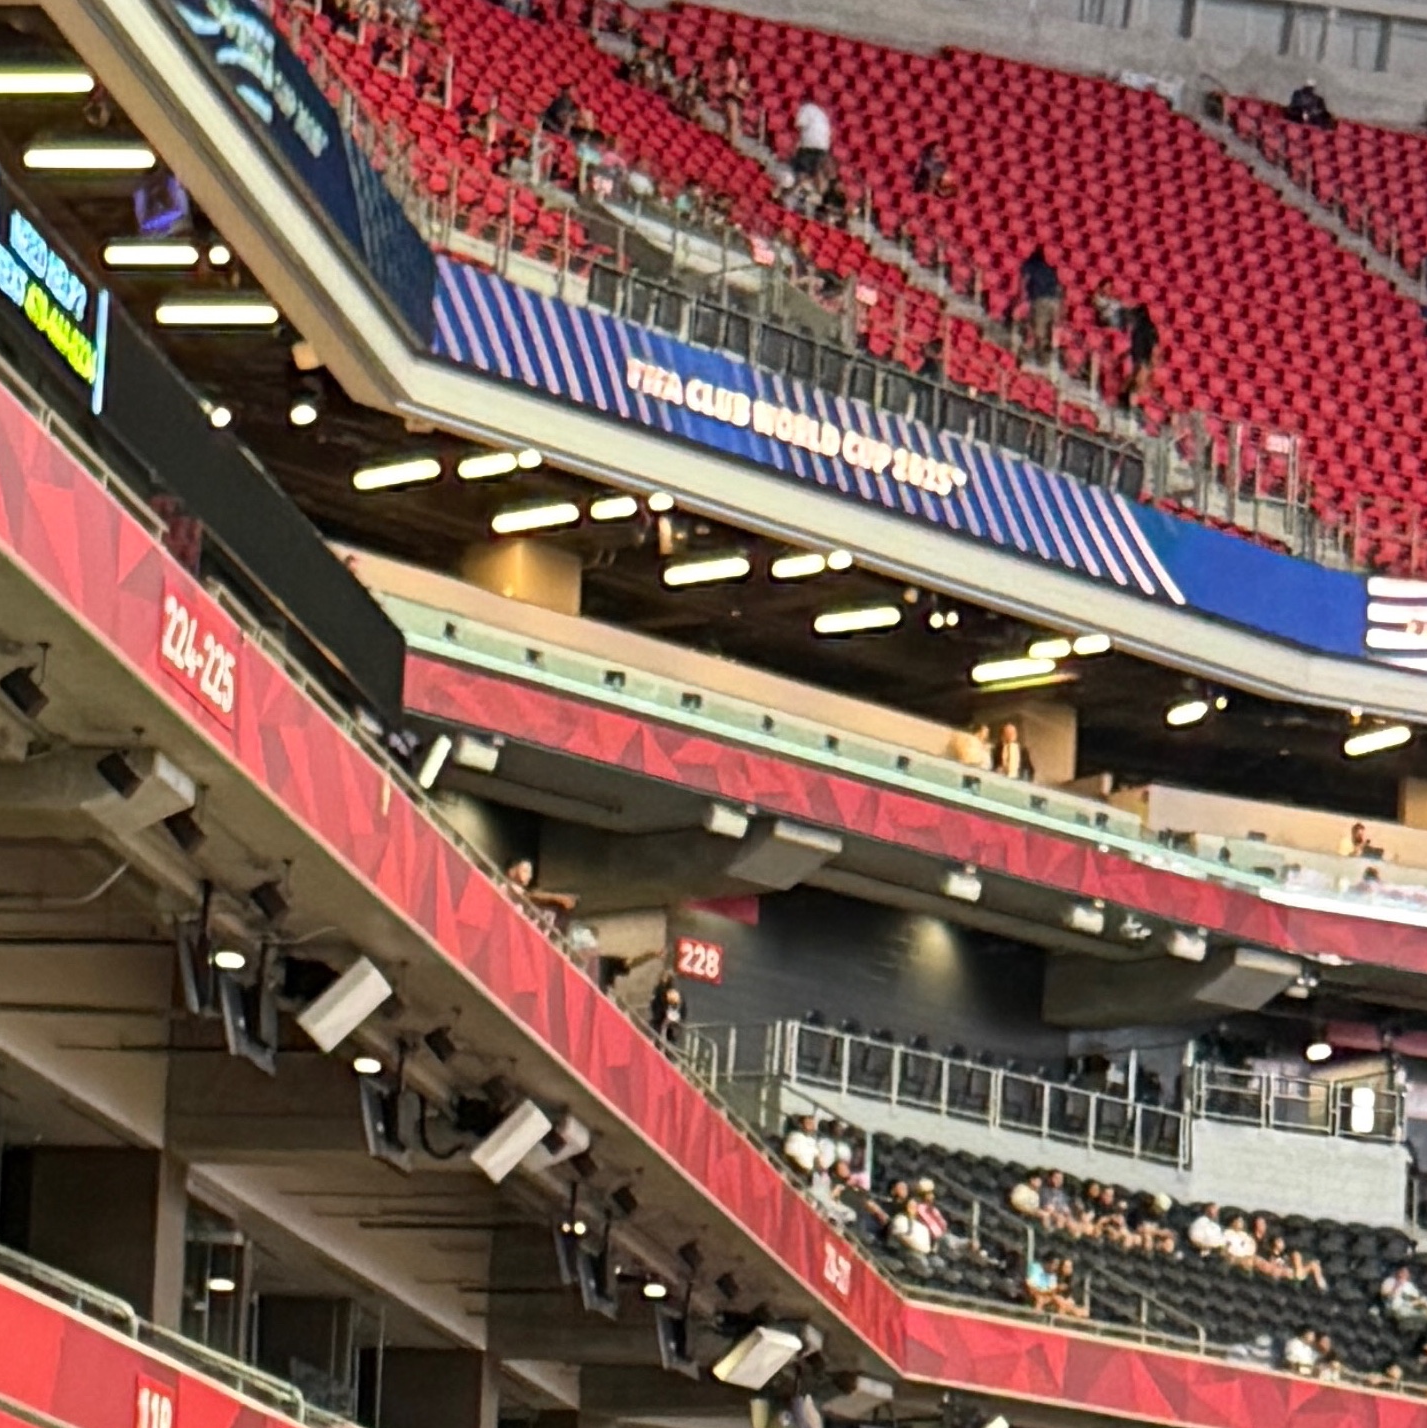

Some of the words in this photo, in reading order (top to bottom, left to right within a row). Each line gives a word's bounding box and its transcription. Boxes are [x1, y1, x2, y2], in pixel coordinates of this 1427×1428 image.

[627, 357, 683, 405] FIFA
[685, 378, 751, 427] CLUB
[753, 399, 841, 457] WORLD
[842, 429, 892, 474] CUP
[161, 595, 237, 713] 224-225
[678, 941, 720, 979] 228
